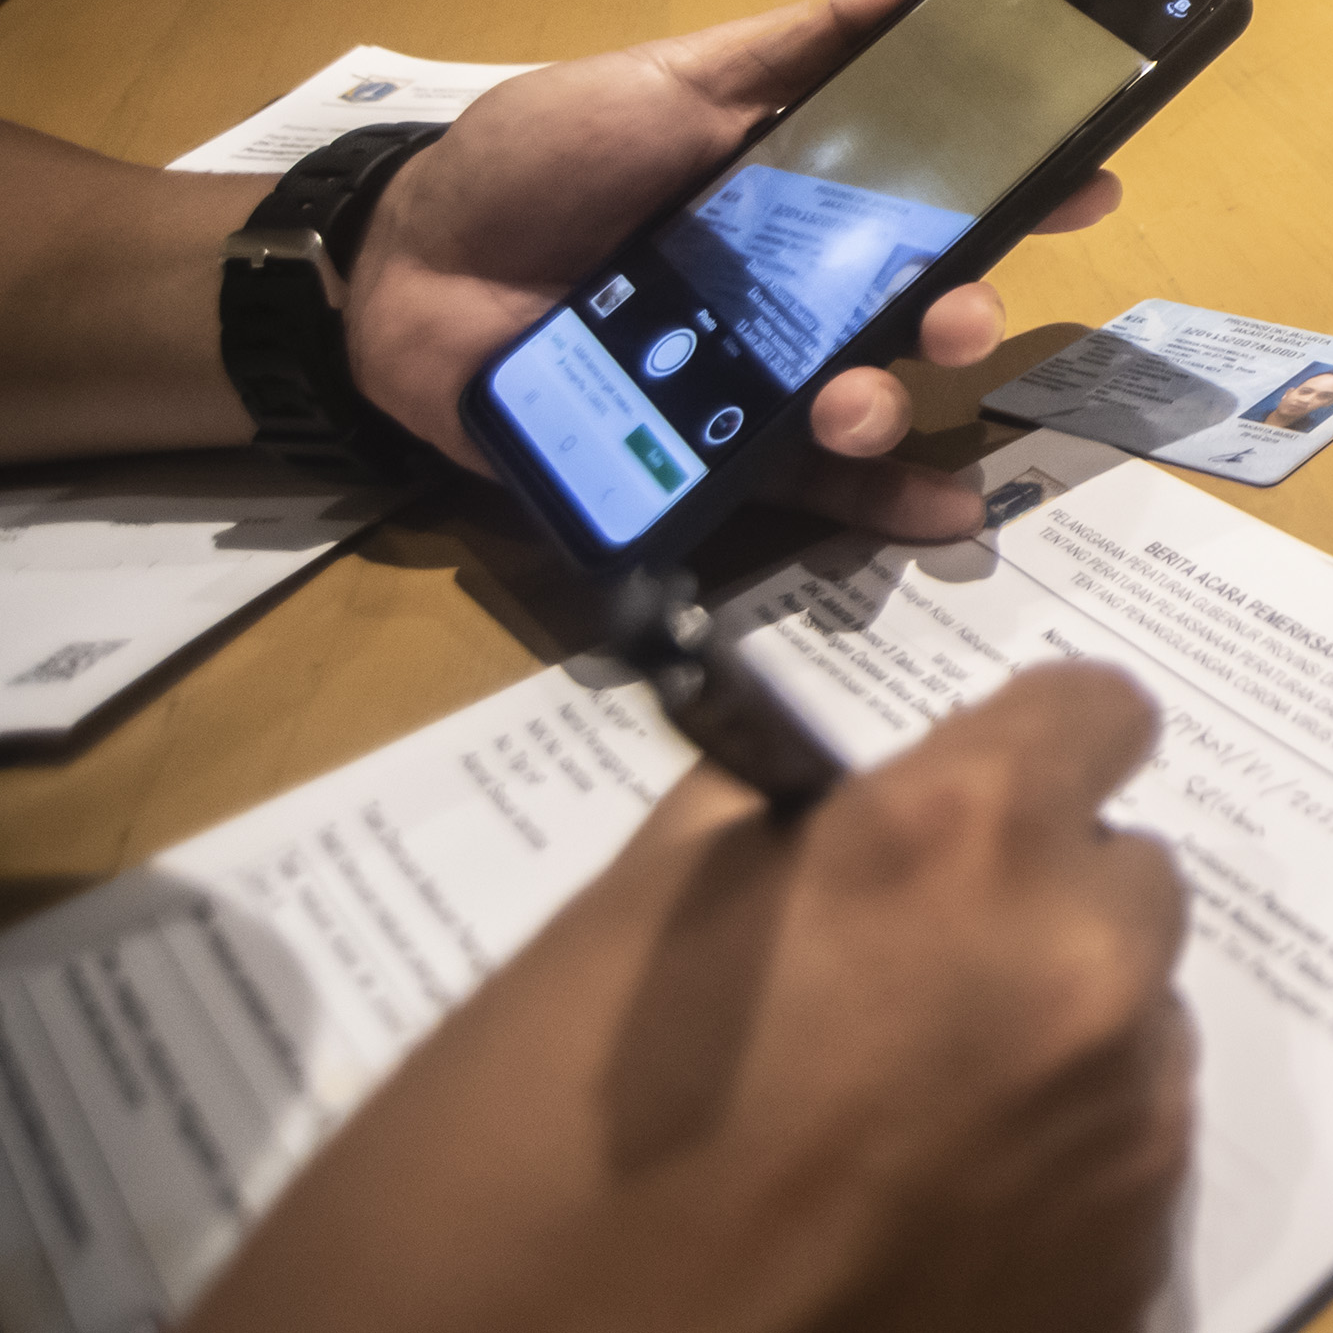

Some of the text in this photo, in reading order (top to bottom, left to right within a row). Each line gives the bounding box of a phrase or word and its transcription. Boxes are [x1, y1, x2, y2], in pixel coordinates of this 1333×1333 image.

[1230, 326, 1274, 341] JAKARTA
[1039, 527, 1088, 563] TENTANG
[1086, 556, 1155, 603] PERATURAN
[1048, 508, 1128, 562] PELANGGARAN
[1124, 553, 1195, 602] PERATURAN
[1192, 595, 1263, 643] GUBERNUR
[1071, 571, 1124, 608] TENTANG
[1144, 540, 1200, 578] BERITA
[1195, 570, 1248, 608] ACARA
